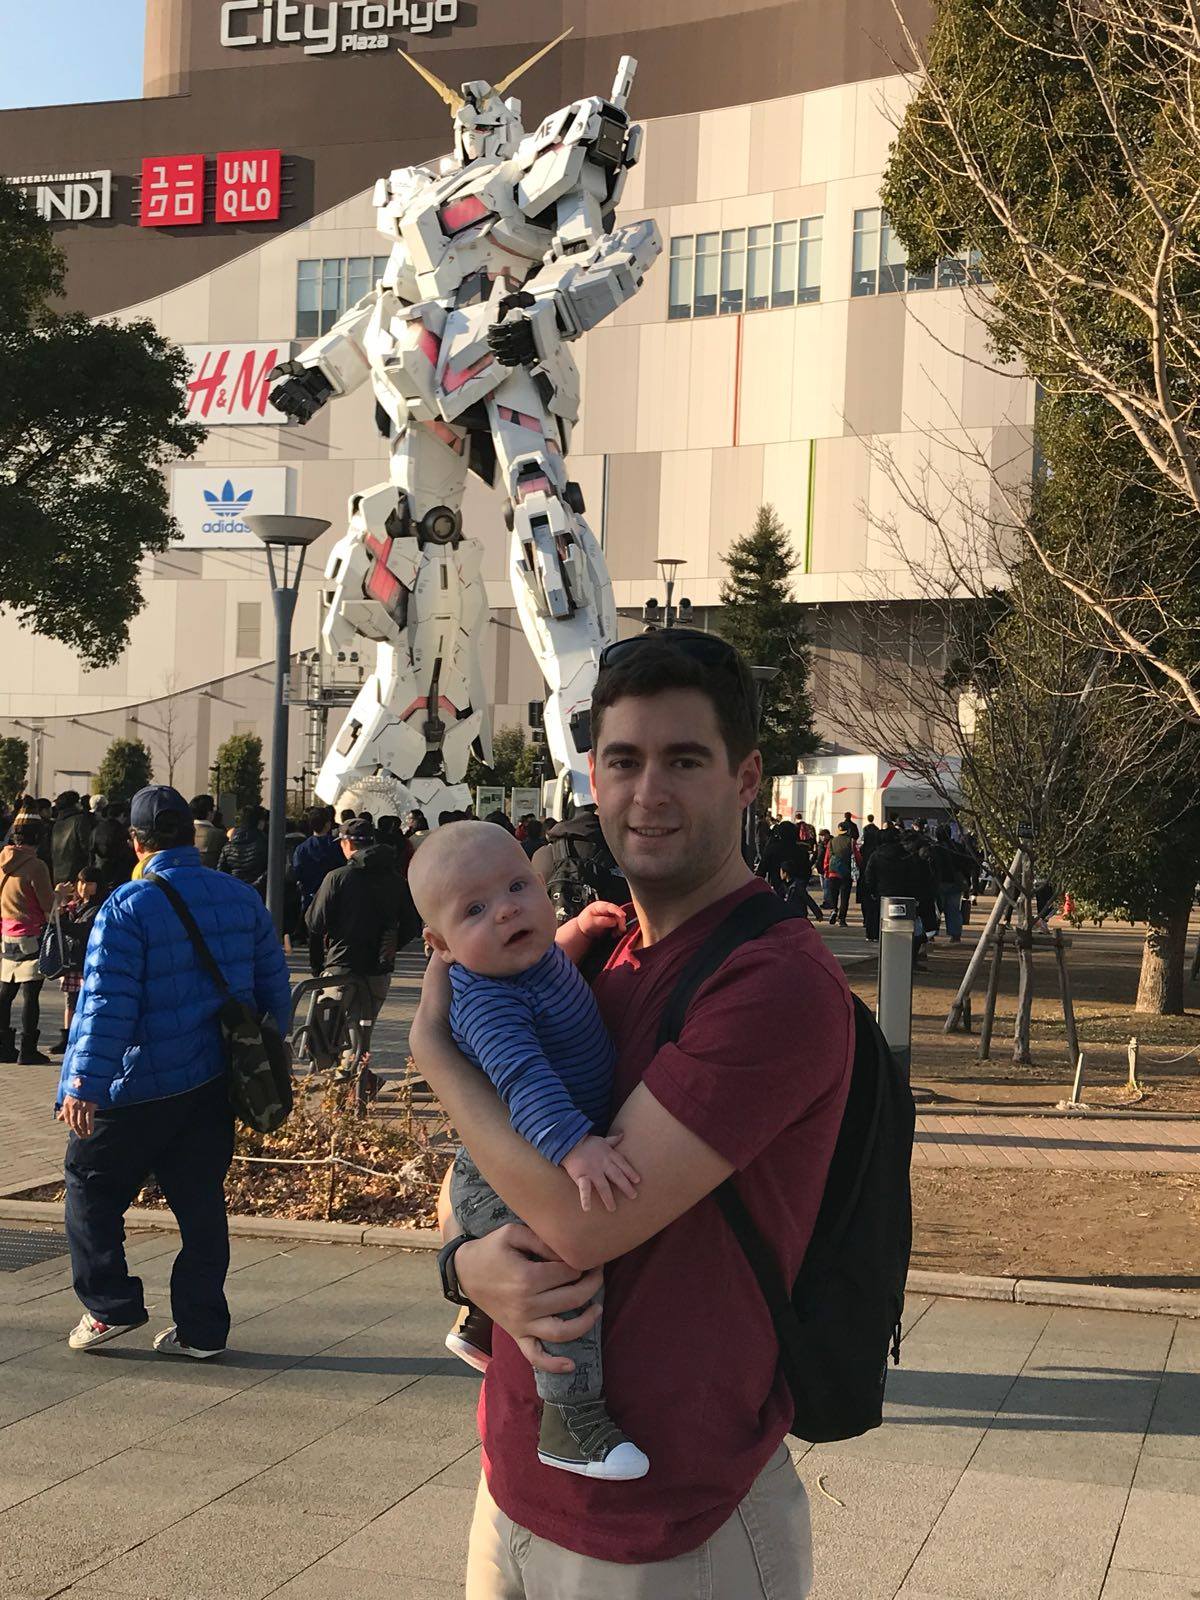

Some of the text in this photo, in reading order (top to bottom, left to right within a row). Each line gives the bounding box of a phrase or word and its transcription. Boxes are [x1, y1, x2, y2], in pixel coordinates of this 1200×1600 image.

[220, 0, 338, 54] City
[342, 34, 389, 51] Plaza
[151, 164, 194, 189] ユニ
[224, 160, 268, 184] UNI
[148, 193, 194, 217] クロ
[223, 188, 271, 216] QLO
[187, 348, 278, 418] H&M
[202, 519, 252, 533] adidas
